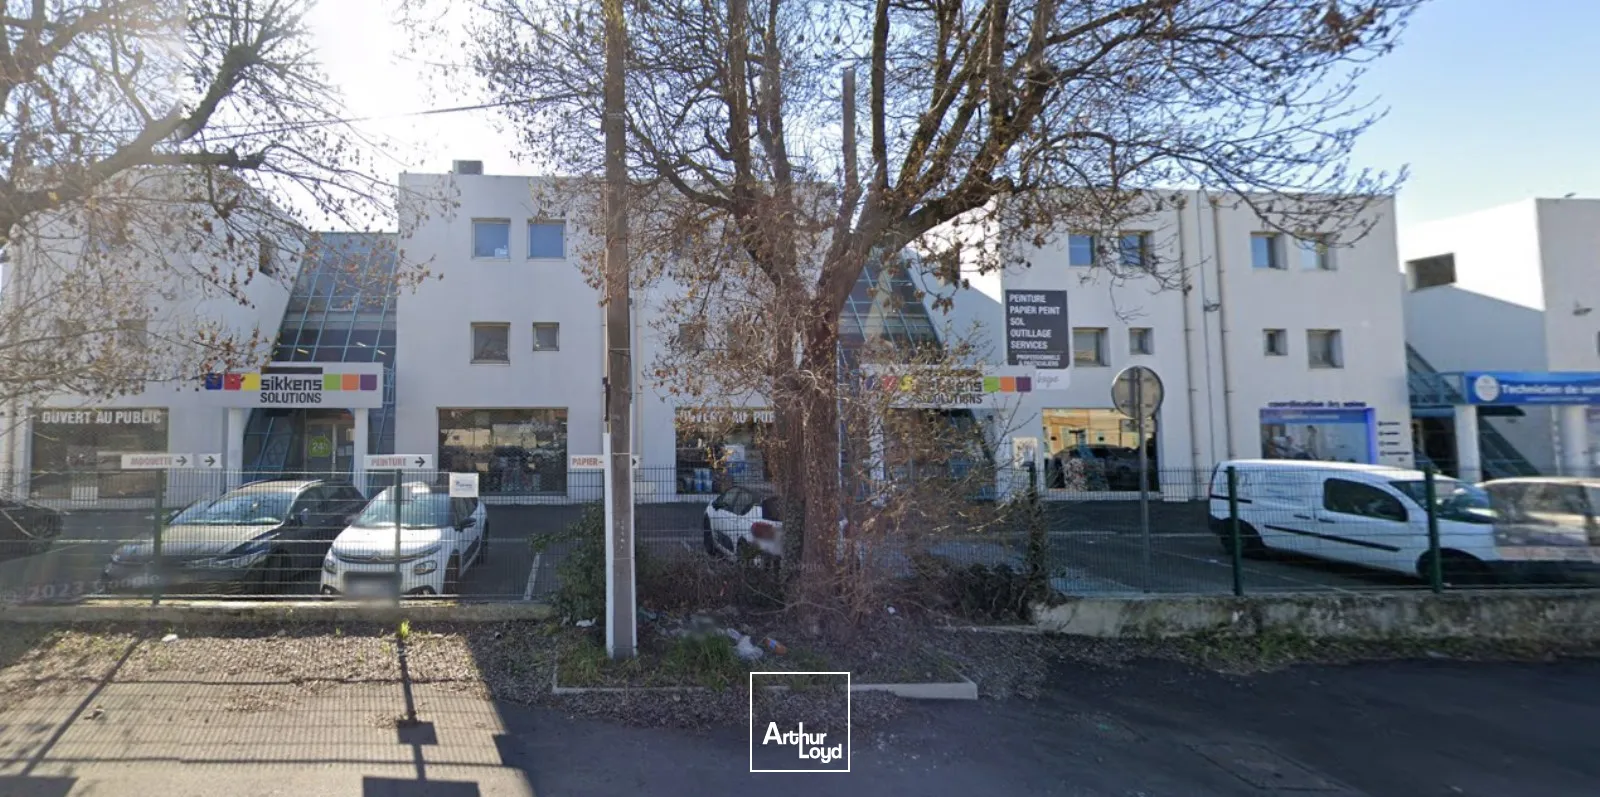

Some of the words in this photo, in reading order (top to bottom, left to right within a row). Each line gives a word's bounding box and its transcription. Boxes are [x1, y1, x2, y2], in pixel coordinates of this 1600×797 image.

[1009, 294, 1046, 303] PEINTURE
[1010, 306, 1037, 315] PAPIER
[1038, 306, 1060, 316] PEINT
[1010, 317, 1026, 326] SOL
[1010, 329, 1052, 338] OUTILLAGE
[1011, 341, 1048, 350] SERVICES
[261, 376, 322, 391] sikkens
[260, 392, 322, 404] SOLUTIONS
[43, 411, 90, 424] OUVERT
[96, 411, 112, 424] AU
[115, 411, 161, 424] PUBLIC
[572, 457, 598, 467] PAPIER
